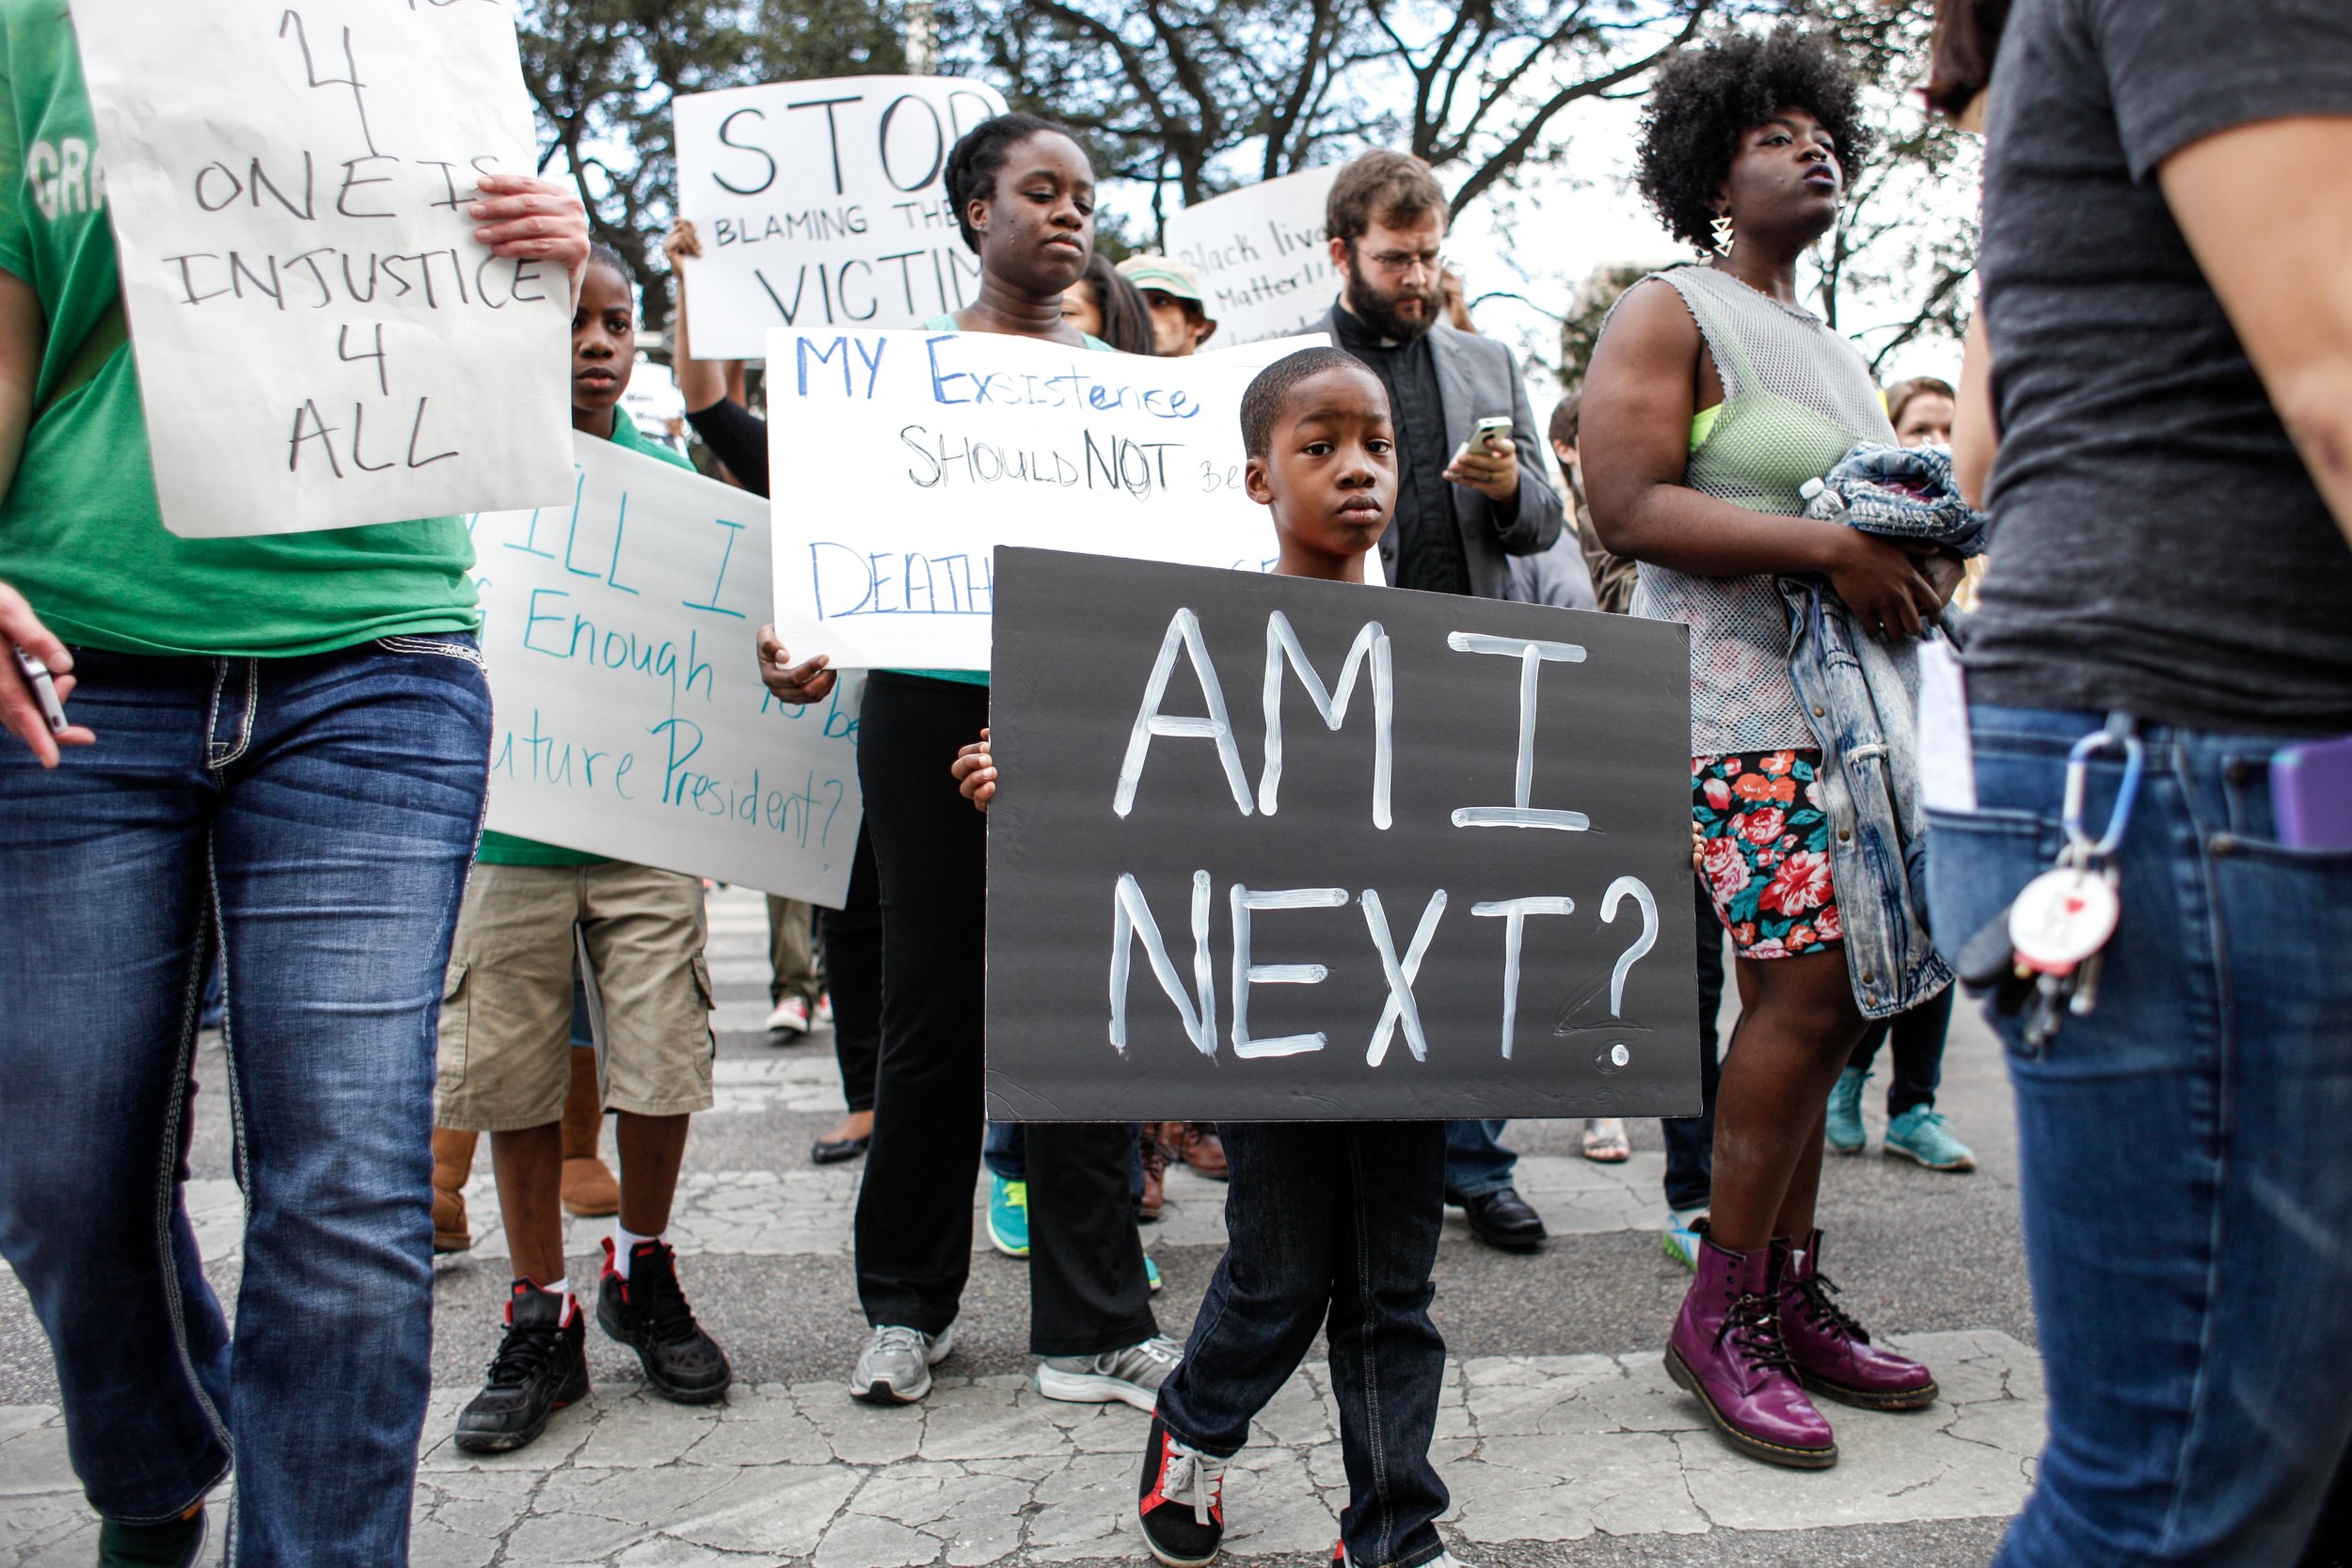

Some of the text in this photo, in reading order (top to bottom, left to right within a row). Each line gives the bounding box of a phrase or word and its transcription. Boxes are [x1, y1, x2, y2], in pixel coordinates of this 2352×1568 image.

[279, 8, 380, 158] 4
[195, 150, 400, 220] ONE
[715, 204, 868, 247] BLAMING
[162, 247, 547, 310] INJUSTICE
[338, 322, 388, 396] 4
[796, 336, 887, 400] MY
[288, 396, 460, 479] ALL
[461, 463, 747, 619] ILL I
[808, 541, 993, 622] DEATH
[523, 588, 714, 726] Enough
[1112, 607, 1592, 831] AM I
[490, 708, 845, 873] uture President?
[1107, 869, 1660, 1069] NEXT?
